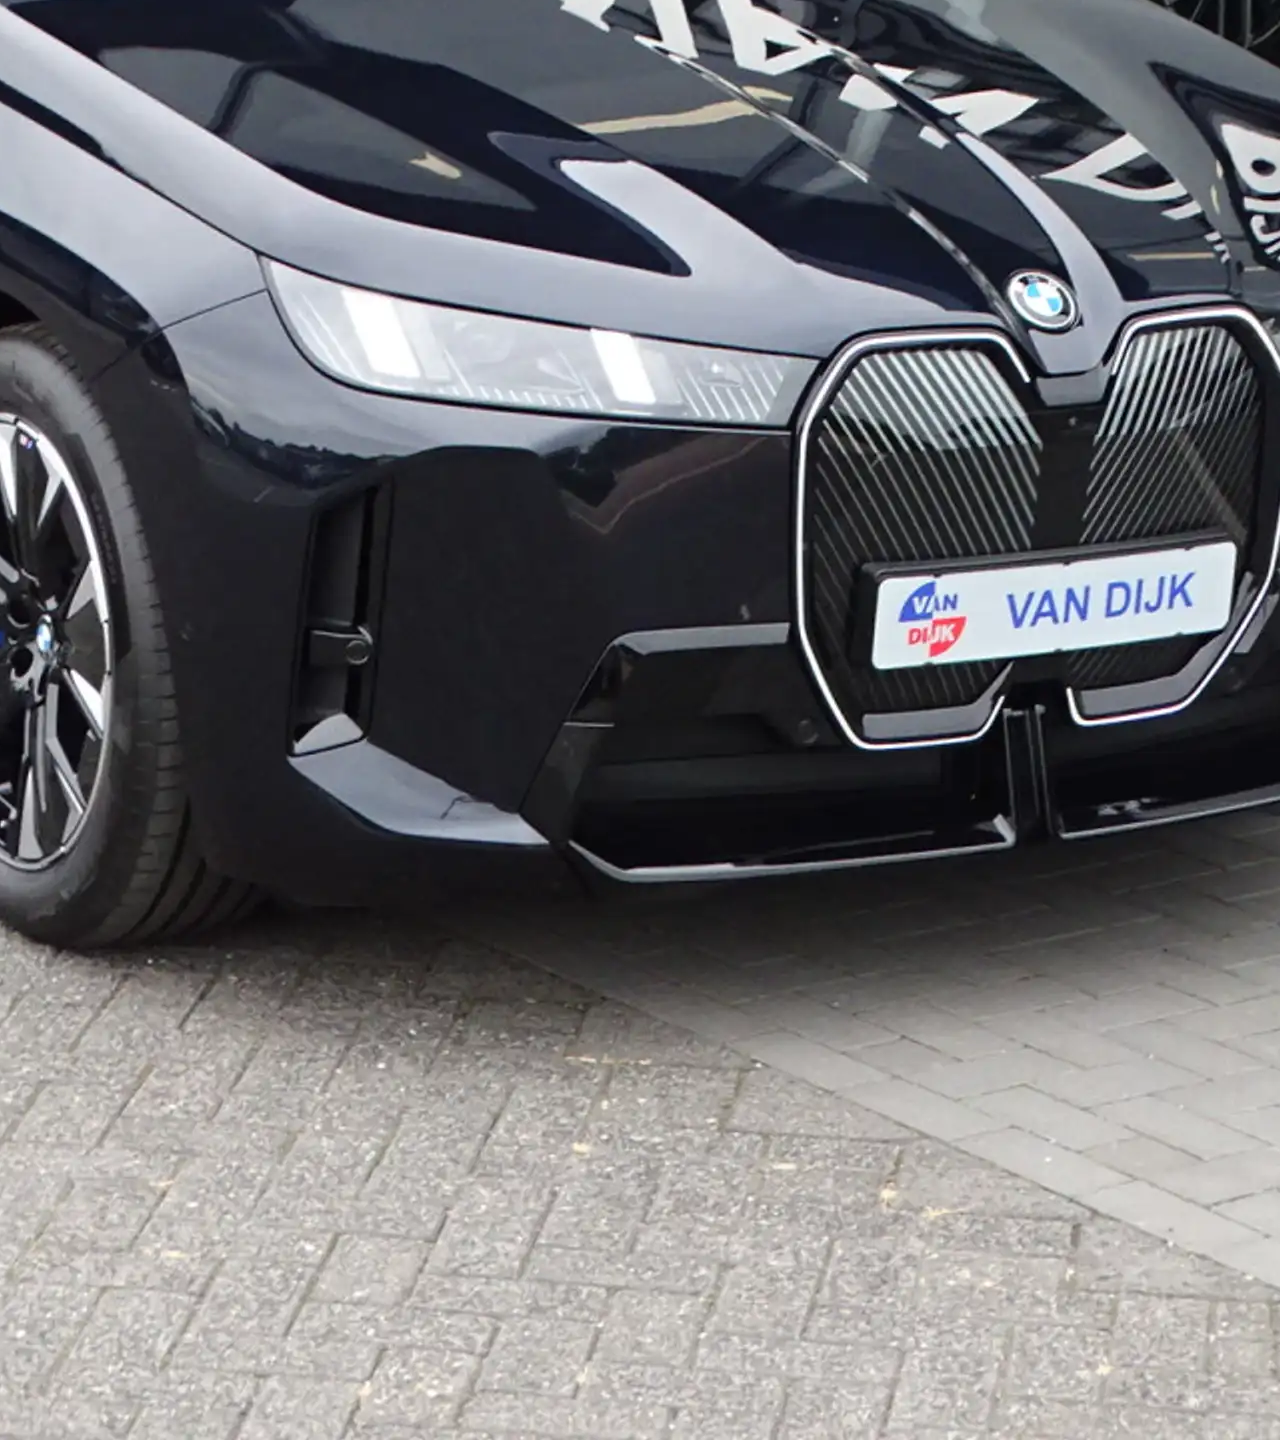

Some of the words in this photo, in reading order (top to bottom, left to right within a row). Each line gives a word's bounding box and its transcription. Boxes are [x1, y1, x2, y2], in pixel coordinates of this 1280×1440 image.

[912, 594, 959, 615] VAN
[1007, 585, 1090, 629] VAN
[1105, 572, 1195, 618] DIJK
[908, 624, 956, 646] DIJK
